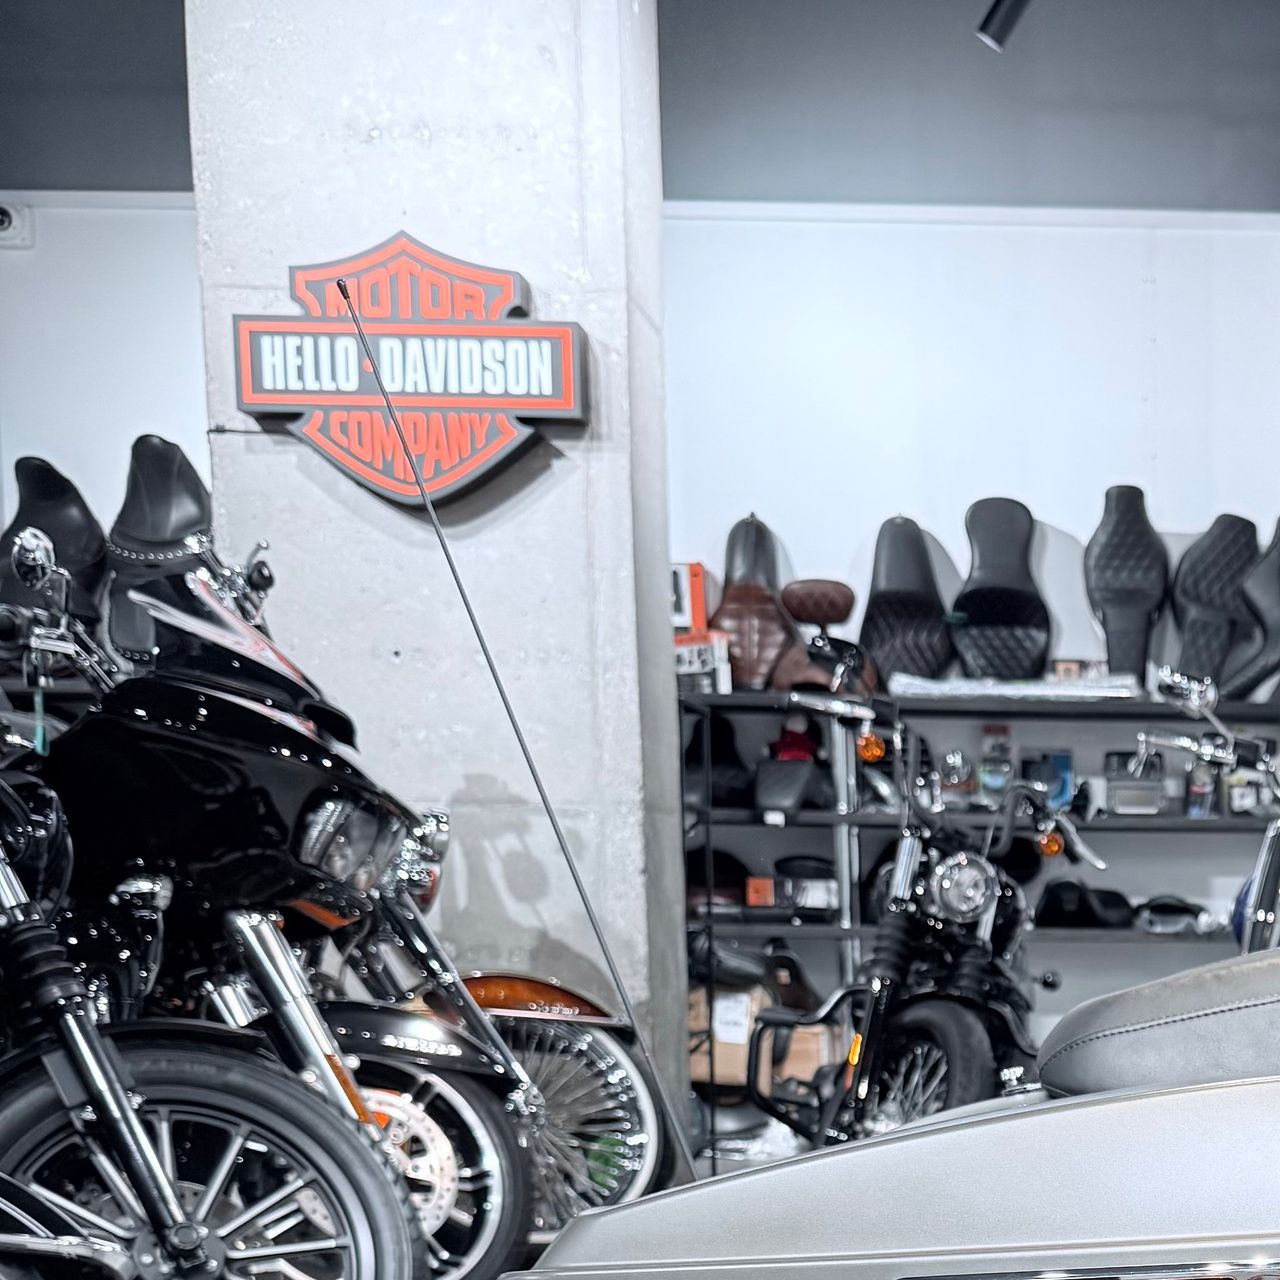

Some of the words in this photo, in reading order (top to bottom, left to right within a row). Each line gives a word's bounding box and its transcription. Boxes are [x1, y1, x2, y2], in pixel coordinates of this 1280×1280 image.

[325, 257, 485, 319] MOTOR
[260, 334, 360, 392] HELLO
[379, 336, 552, 395] DAVIDSON
[329, 412, 491, 481] COMPANY
